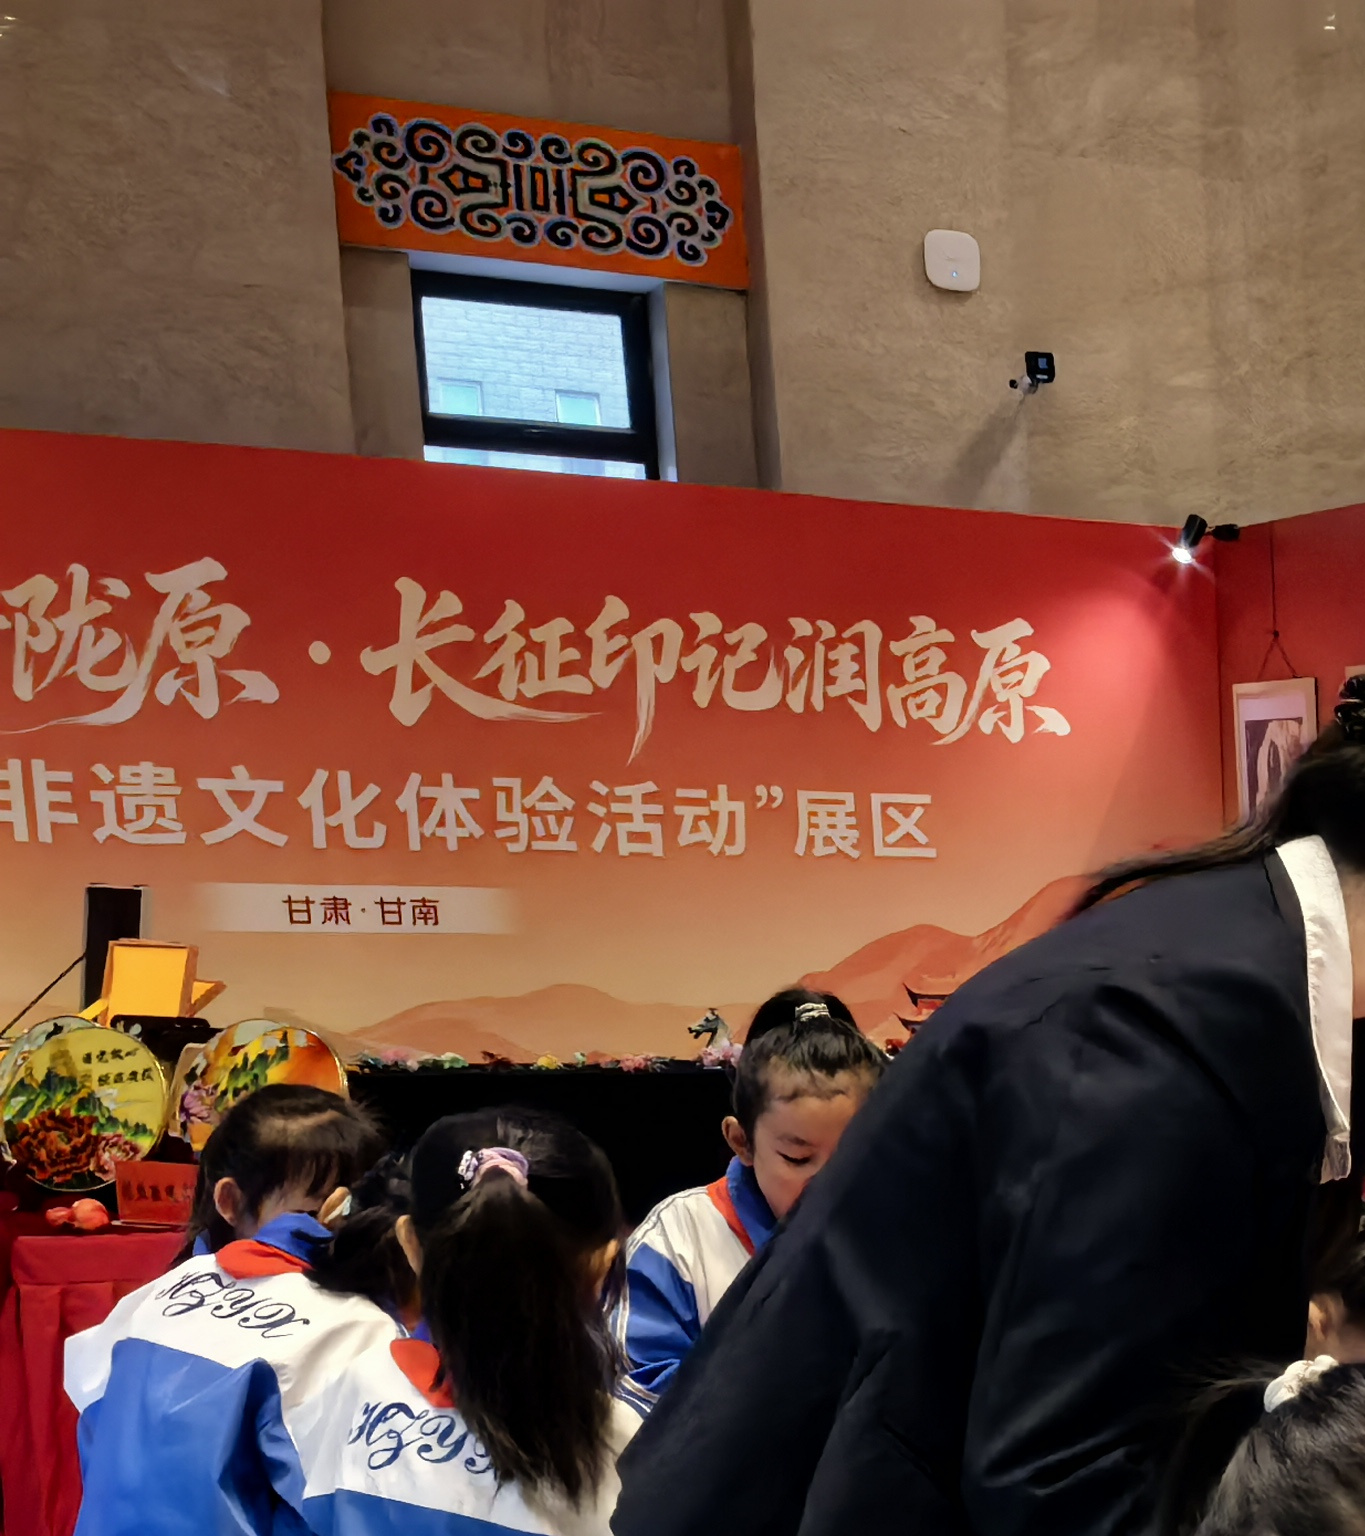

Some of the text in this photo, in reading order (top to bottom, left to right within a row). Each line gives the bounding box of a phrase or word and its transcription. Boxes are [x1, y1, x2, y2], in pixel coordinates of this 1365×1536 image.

[0, 557, 1071, 766] 陇原·长征印记润高原
[282, 895, 440, 926] 甘肃·甘南
